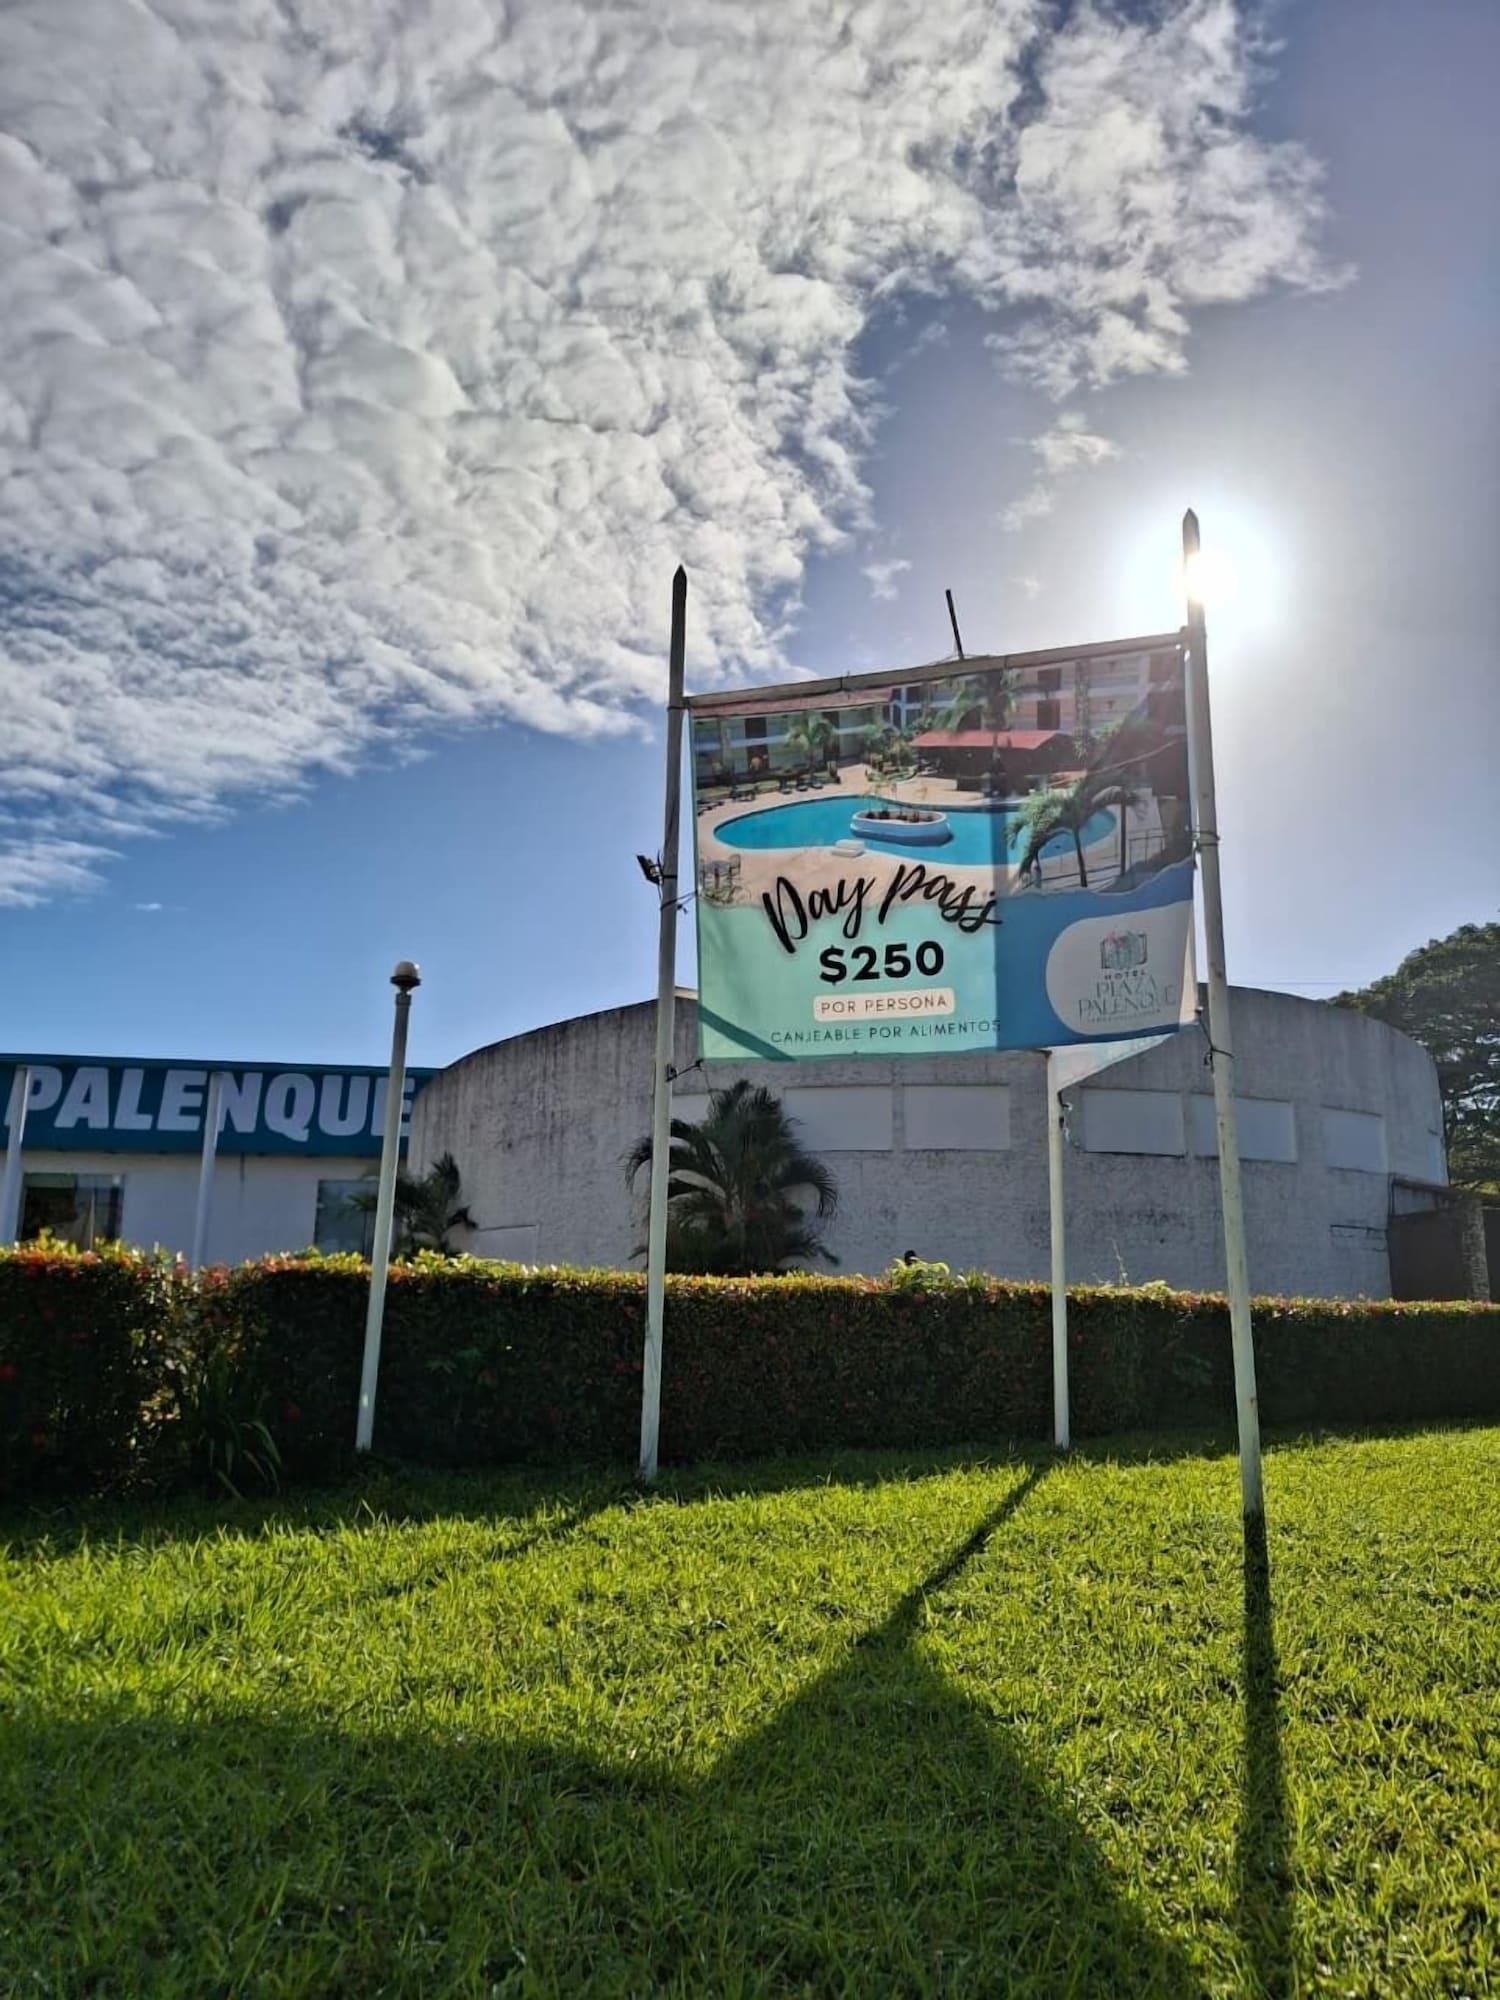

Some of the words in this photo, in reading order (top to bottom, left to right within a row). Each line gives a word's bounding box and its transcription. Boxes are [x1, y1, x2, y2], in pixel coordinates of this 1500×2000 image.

[761, 876, 876, 954] Day
[819, 940, 944, 986] $250
[1103, 969, 1147, 981] HOTEL
[1096, 974, 1158, 998] PLAZA
[821, 1001, 856, 1014] POR
[865, 996, 949, 1012] PERSONA
[770, 1029, 861, 1043] CANJEABLE
[869, 1026, 902, 1039] POR
[910, 1019, 1001, 1038] ALIMENTOS
